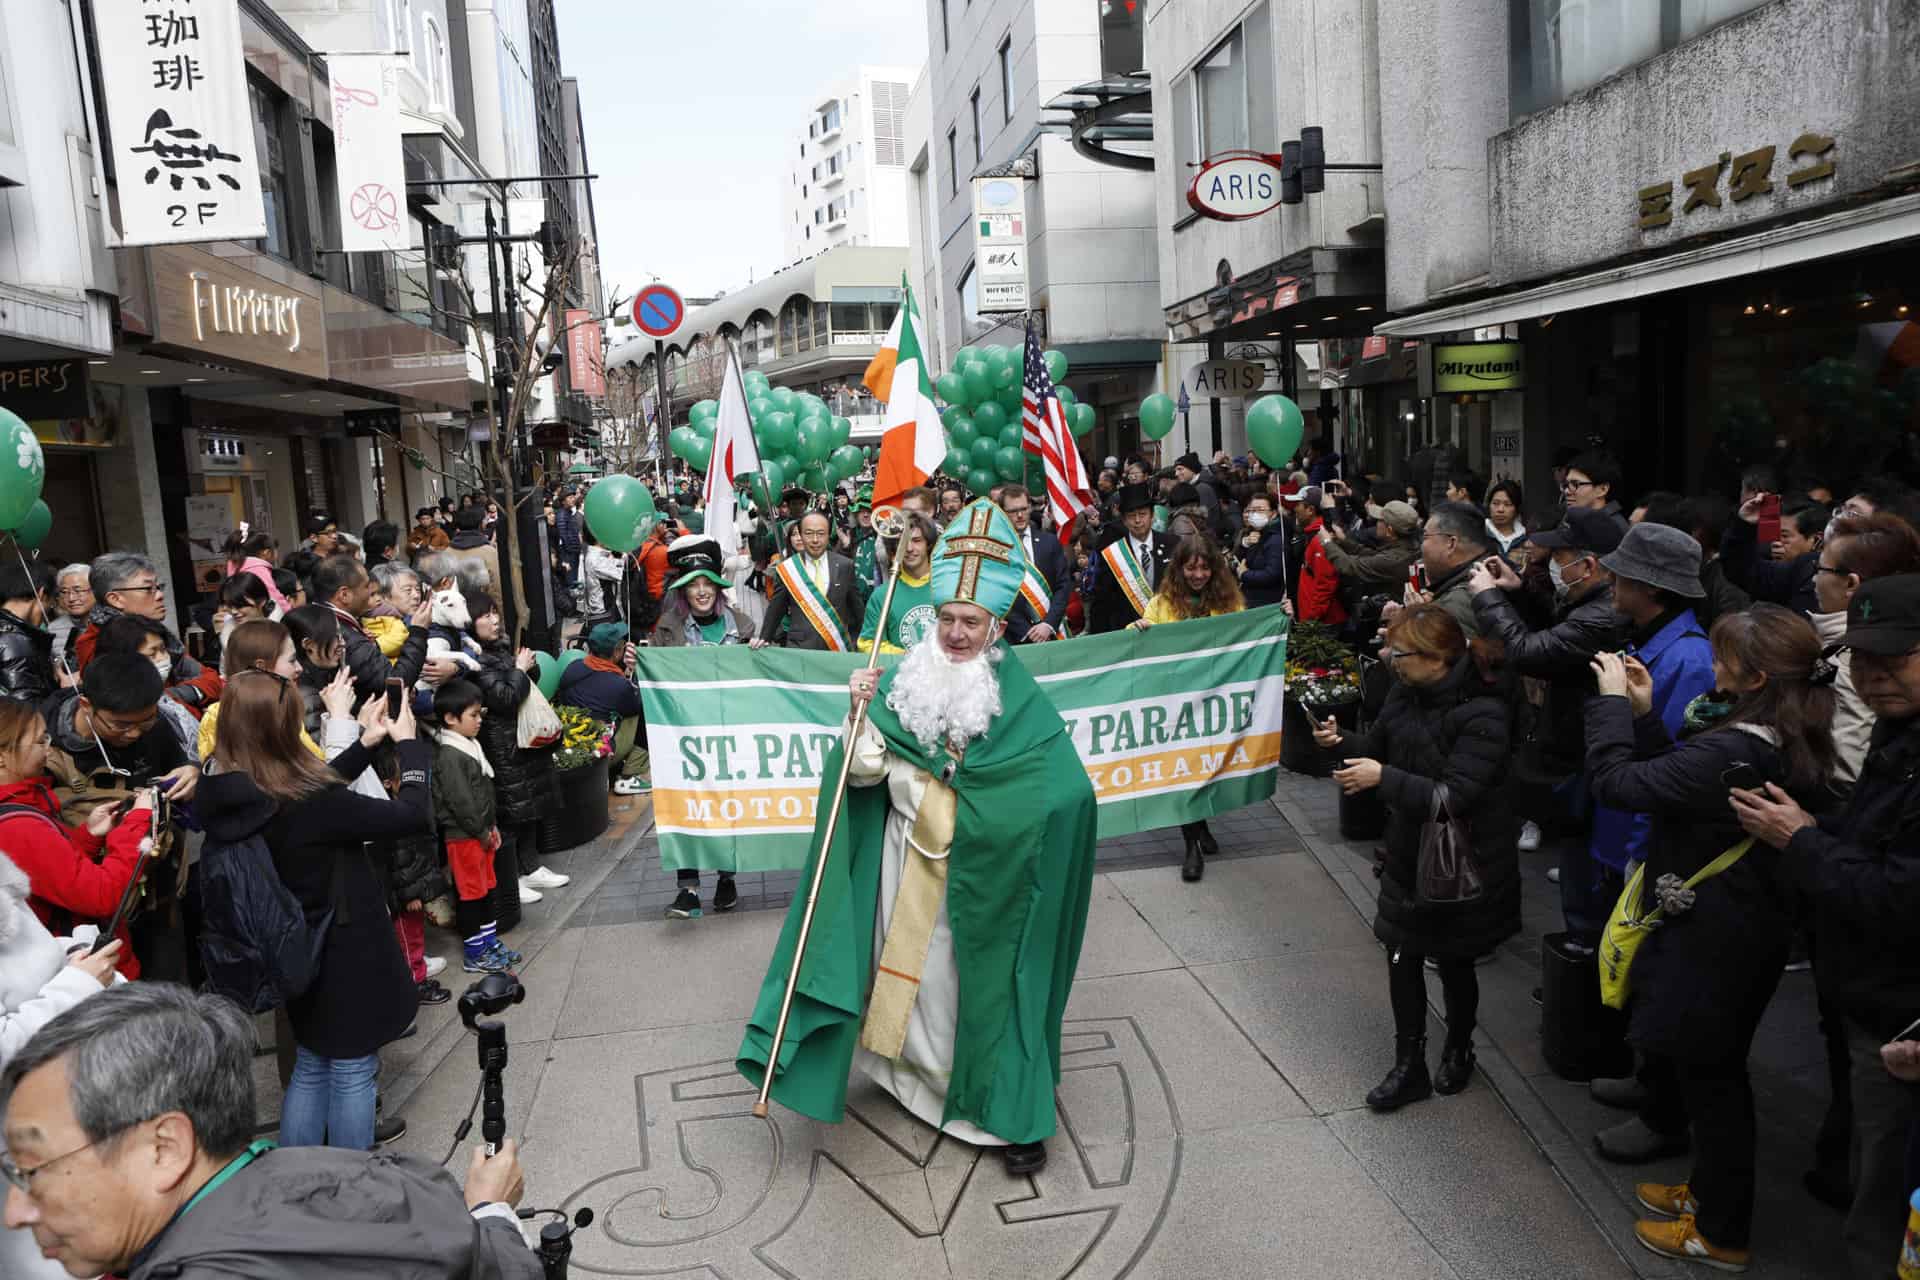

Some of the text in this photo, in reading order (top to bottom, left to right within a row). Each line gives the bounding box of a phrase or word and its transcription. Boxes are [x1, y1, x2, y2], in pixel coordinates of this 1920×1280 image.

[143, 0, 205, 91] 珈琲
[1210, 173, 1273, 201] ARIS
[166, 202, 218, 227] 2F
[0, 362, 72, 393] PER'S
[1195, 367, 1255, 391] ARIS
[1088, 690, 1256, 756] PARADE
